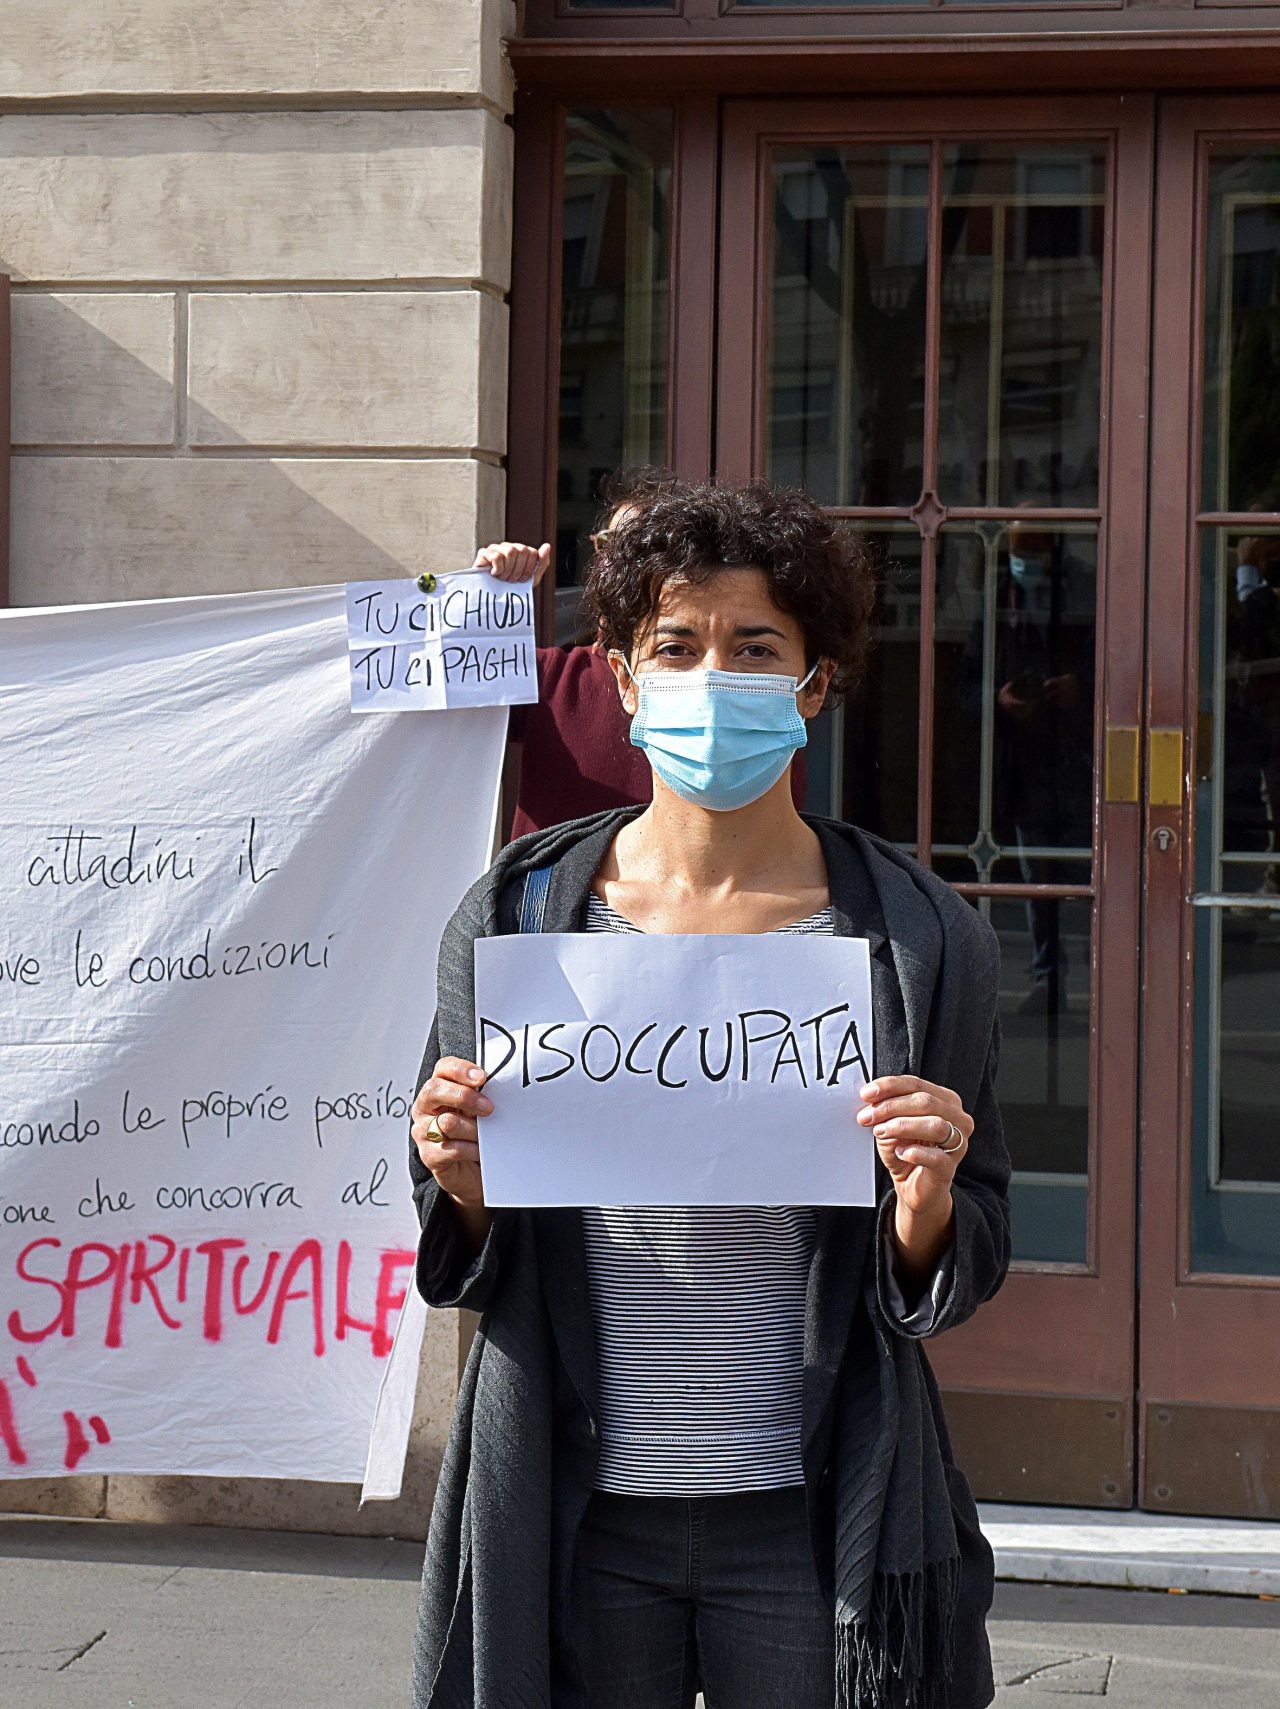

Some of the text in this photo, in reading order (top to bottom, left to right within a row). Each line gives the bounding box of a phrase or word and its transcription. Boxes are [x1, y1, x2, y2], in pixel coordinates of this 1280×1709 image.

[355, 592, 398, 634] TU
[443, 589, 531, 630] CHIUDI
[355, 645, 396, 691] TU
[439, 643, 529, 683] PAGHI
[28, 825, 202, 890] cittadini
[238, 817, 279, 883] il
[75, 929, 107, 987] le
[128, 928, 336, 985] condizioni
[479, 1003, 872, 1092] DISOCCUPATA
[123, 1089, 166, 1134] le
[181, 1086, 290, 1148] proprie
[315, 1080, 413, 1148] possibi
[78, 1177, 135, 1217] che
[156, 1185, 303, 1213] concorra
[342, 1158, 389, 1207] al
[7, 1234, 417, 1358] SPIRITUALE
